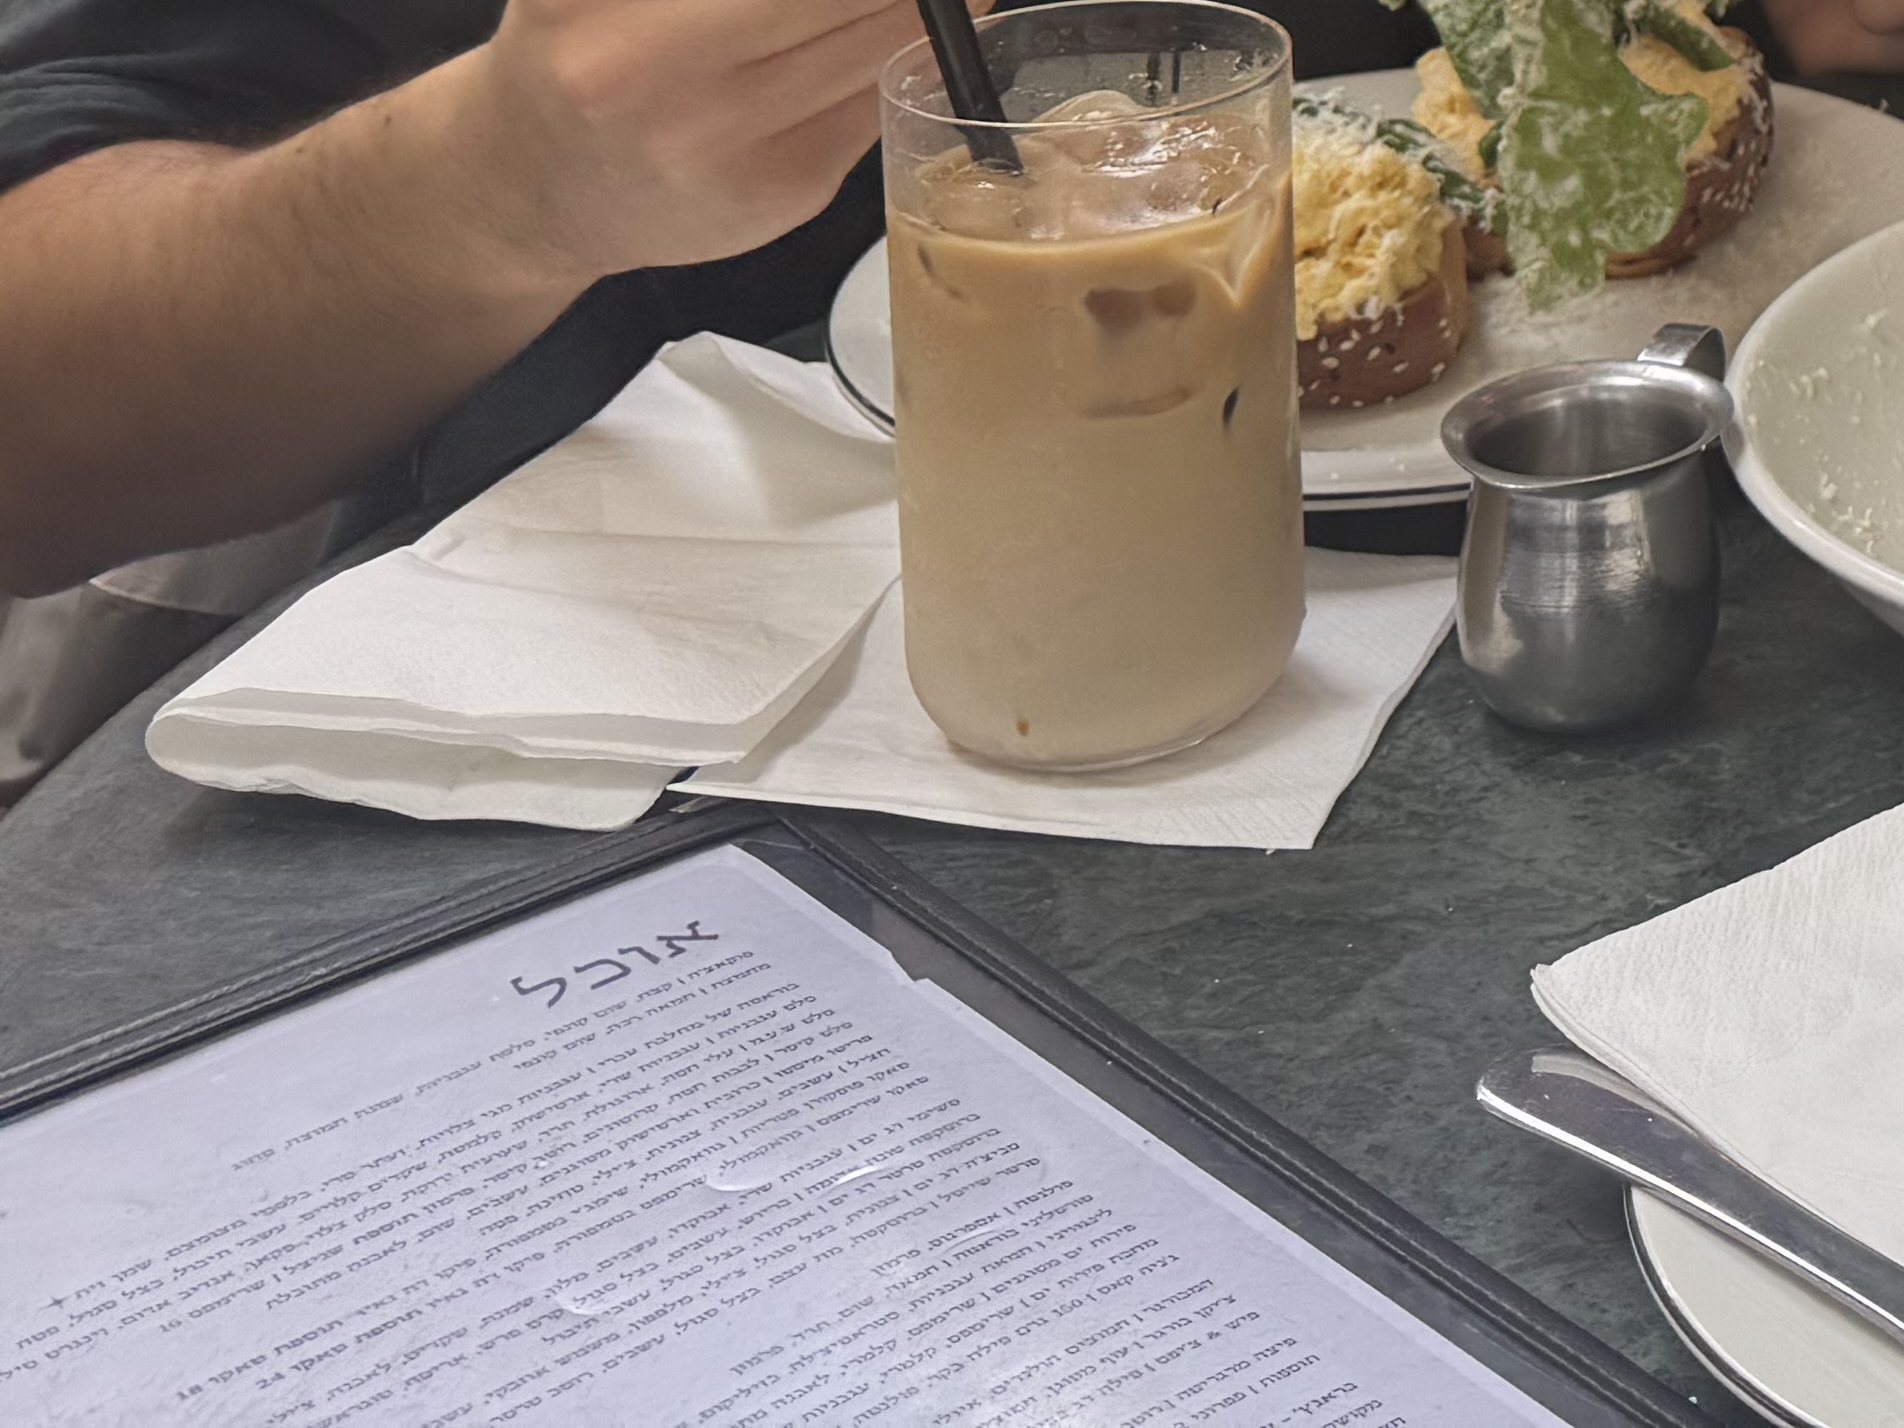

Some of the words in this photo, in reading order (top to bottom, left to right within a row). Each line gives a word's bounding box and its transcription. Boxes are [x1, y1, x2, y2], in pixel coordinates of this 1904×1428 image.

[510, 920, 720, 1009] אוכל
[592, 1000, 627, 1018] שום
[645, 992, 697, 1017] חמאה
[704, 1007, 732, 1023] של
[782, 995, 817, 1012] סלט
[716, 1010, 778, 1039] עגבניות
[800, 1008, 836, 1025] סלט
[562, 1032, 596, 1051] שום
[643, 1021, 706, 1049] מחלבת
[818, 1021, 853, 1038] סלט
[703, 1048, 734, 1063] עלי
[773, 1036, 815, 1054] קיסר
[826, 1035, 874, 1056] פריטו
[512, 1049, 558, 1070] קונפי
[597, 1048, 638, 1067] עברי
[637, 1042, 700, 1073] עגבניות
[845, 1048, 891, 1068] חציל
[711, 1058, 760, 1083] לבבות
[865, 1062, 910, 1082] טאקו
[517, 1072, 582, 1106] עגבניות
[703, 1081, 761, 1109] כרובית
[778, 1071, 834, 1101] עשבים,
[885, 1076, 929, 1096] טאקו
[479, 1103, 513, 1118] מגי
[816, 1095, 881, 1126] שרימפס
[906, 1098, 961, 1122] סשימי
[614, 1108, 701, 1151] וארטישוק
[740, 1108, 801, 1139] פטריות
[883, 1122, 904, 1135] דג
[857, 1133, 878, 1146] ים
[458, 1140, 528, 1174] שעועית
[779, 1148, 843, 1183] עגבניות
[994, 1157, 1041, 1176] טרטר
[877, 1160, 925, 1180] טרטר
[937, 1165, 962, 1180] דג
[639, 1174, 707, 1210] שרימפס
[854, 1182, 876, 1195] דג
[913, 1178, 934, 1191] ים
[936, 1176, 992, 1203] שייטל
[1013, 1180, 1074, 1210] פולנטה
[250, 1191, 313, 1217] בלסמי
[353, 1201, 392, 1223] סלק
[827, 1193, 849, 1207] ים
[1020, 1194, 1094, 1227] טורטליני
[235, 1223, 287, 1247] עשבי
[352, 1212, 420, 1246] תוספת
[478, 1214, 519, 1236] פטה
[798, 1225, 838, 1244] בצל
[1089, 1224, 1137, 1248] פירות
[281, 1244, 344, 1275] שניצל
[503, 1252, 546, 1273] פיקו
[705, 1245, 746, 1265] בצל
[869, 1249, 922, 1277] פרמזן
[1062, 1246, 1083, 1260] ים
[1107, 1238, 1159, 1265] מחבת
[110, 1259, 152, 1283] שמן
[433, 1258, 477, 1279] פיקו
[619, 1262, 660, 1283] בצל
[989, 1258, 1062, 1294] מטוגנים
[74, 1280, 106, 1300] זית
[121, 1279, 165, 1301] בצל
[177, 1270, 236, 1301] אנדיב
[719, 1287, 762, 1308] בצל
[1029, 1288, 1051, 1301] ים
[1141, 1278, 1214, 1313] המבורגר
[187, 1279, 266, 1319] שרימפס
[602, 1289, 651, 1316] עשבי
[354, 1308, 423, 1344] תוספת
[524, 1308, 572, 1330] קרם
[541, 1315, 600, 1346] תיבול
[945, 1305, 1014, 1349] שרימפס,
[1014, 1317, 1050, 1336] גרם
[1142, 1317, 1193, 1340] בורגר
[1223, 1311, 1260, 1330] פיש
[16, 1326, 60, 1350] פטה
[273, 1314, 352, 1357] תוספת
[1064, 1319, 1131, 1355] חמוצים
[288, 1343, 349, 1372] טאקו
[553, 1332, 621, 1367] משמש
[965, 1336, 1012, 1363] פילה
[1099, 1346, 1129, 1365] עוף
[1252, 1337, 1298, 1362] פיצה
[207, 1354, 268, 1384] טאקו
[255, 1372, 286, 1390] 24
[1174, 1360, 1252, 1401] מרגריטה
[1258, 1354, 1321, 1388] תוספות
[770, 1374, 830, 1410] לאבנה
[1096, 1369, 1144, 1397] פילה
[801, 1382, 870, 1423] עגבניות
[1190, 1391, 1247, 1420] פפרוני
